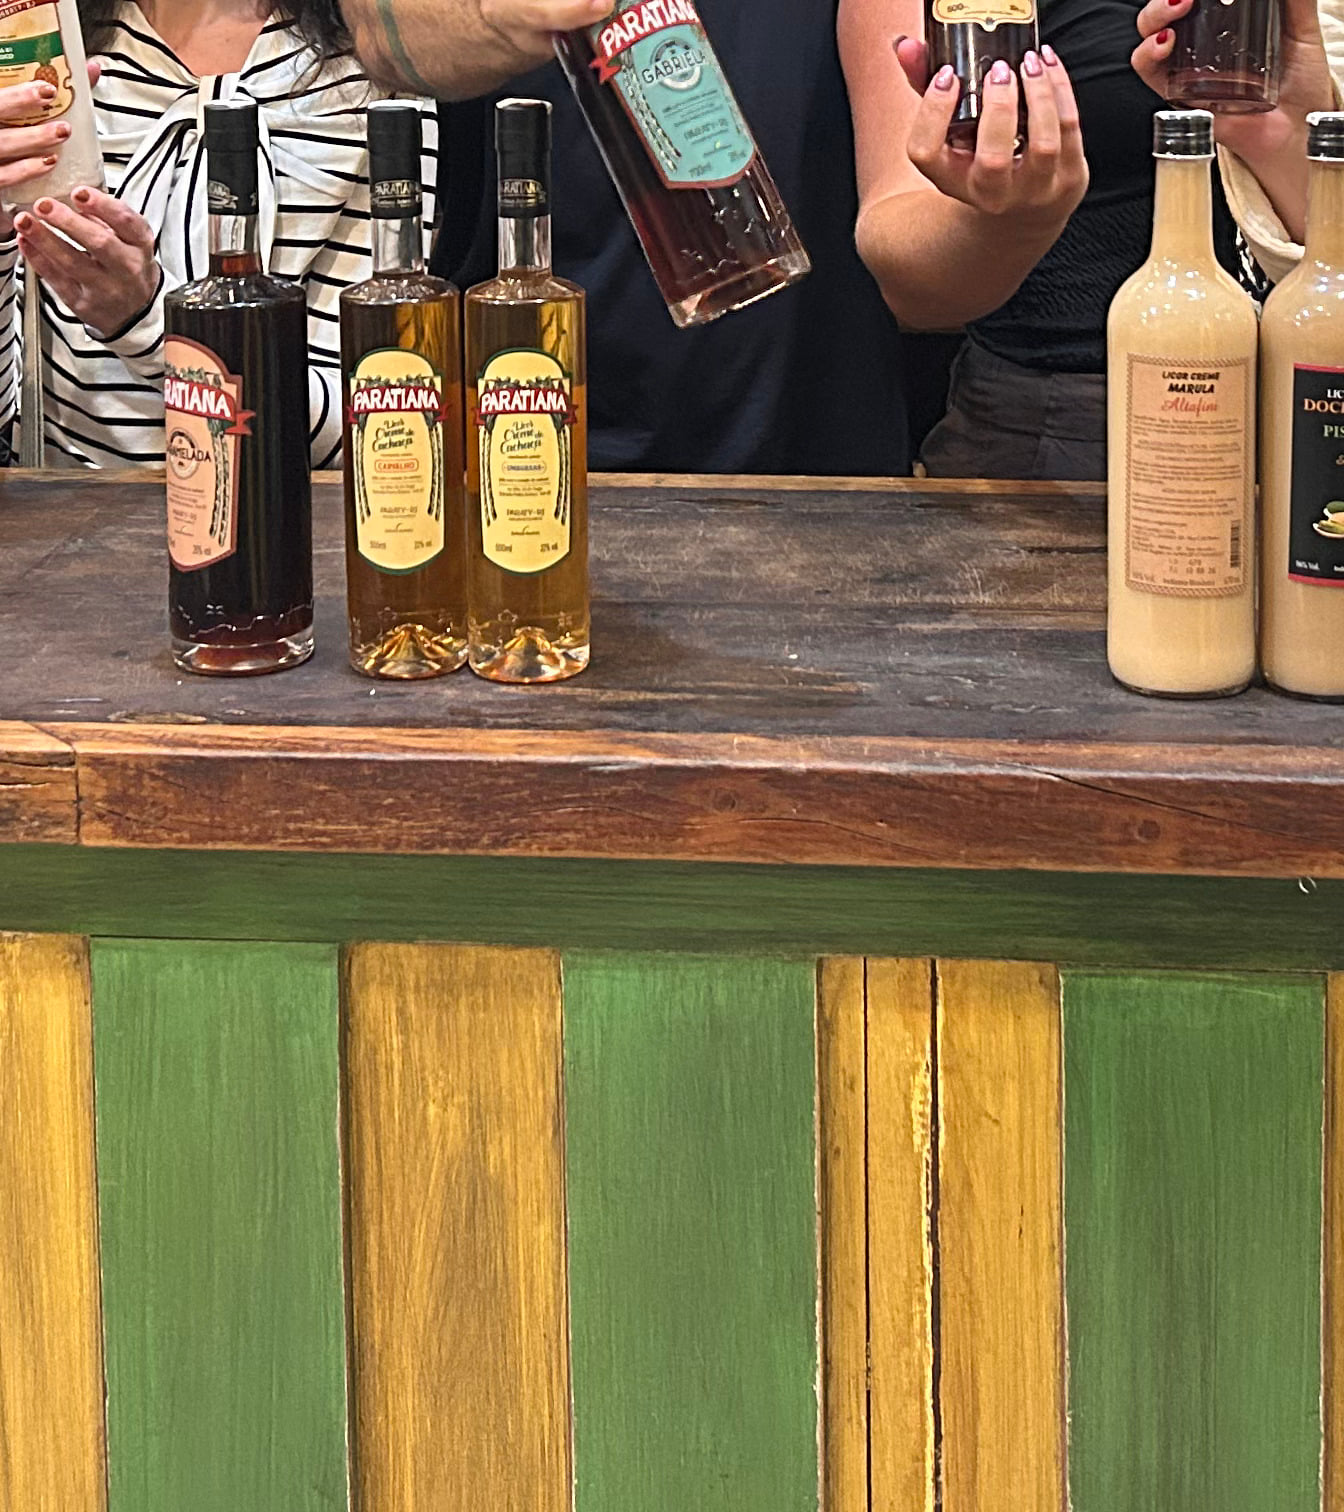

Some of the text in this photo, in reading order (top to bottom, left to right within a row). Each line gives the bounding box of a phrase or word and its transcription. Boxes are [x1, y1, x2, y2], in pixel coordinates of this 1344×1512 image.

[1162, 371, 1220, 381] LICOR CREME
[1168, 384, 1215, 394] MARULA
[354, 388, 438, 411] PARATIANA
[481, 390, 566, 413] PARATIANA
[1161, 397, 1218, 417] Altafini
